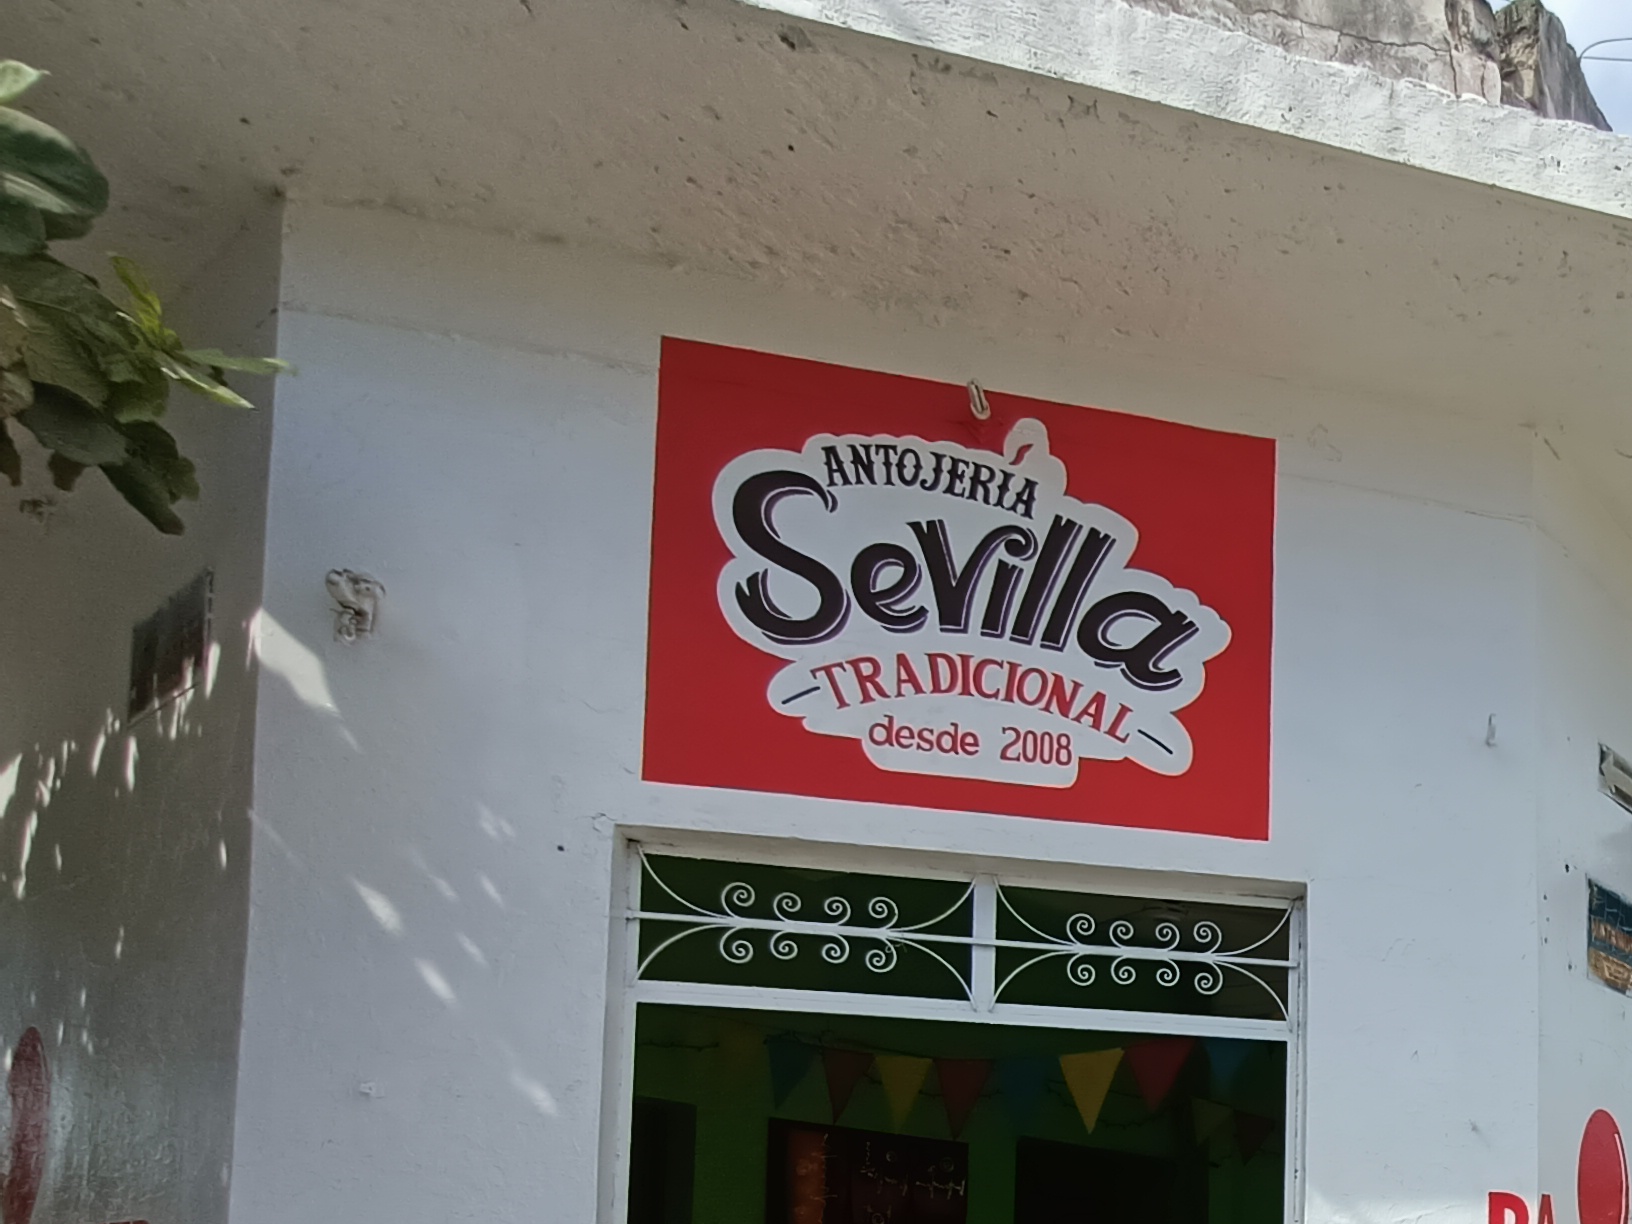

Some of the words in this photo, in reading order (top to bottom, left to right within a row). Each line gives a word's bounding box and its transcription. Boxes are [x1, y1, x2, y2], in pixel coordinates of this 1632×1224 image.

[811, 652, 1133, 745] TRADICIONAL
[868, 714, 980, 758] desde
[999, 726, 1073, 767] 2008
